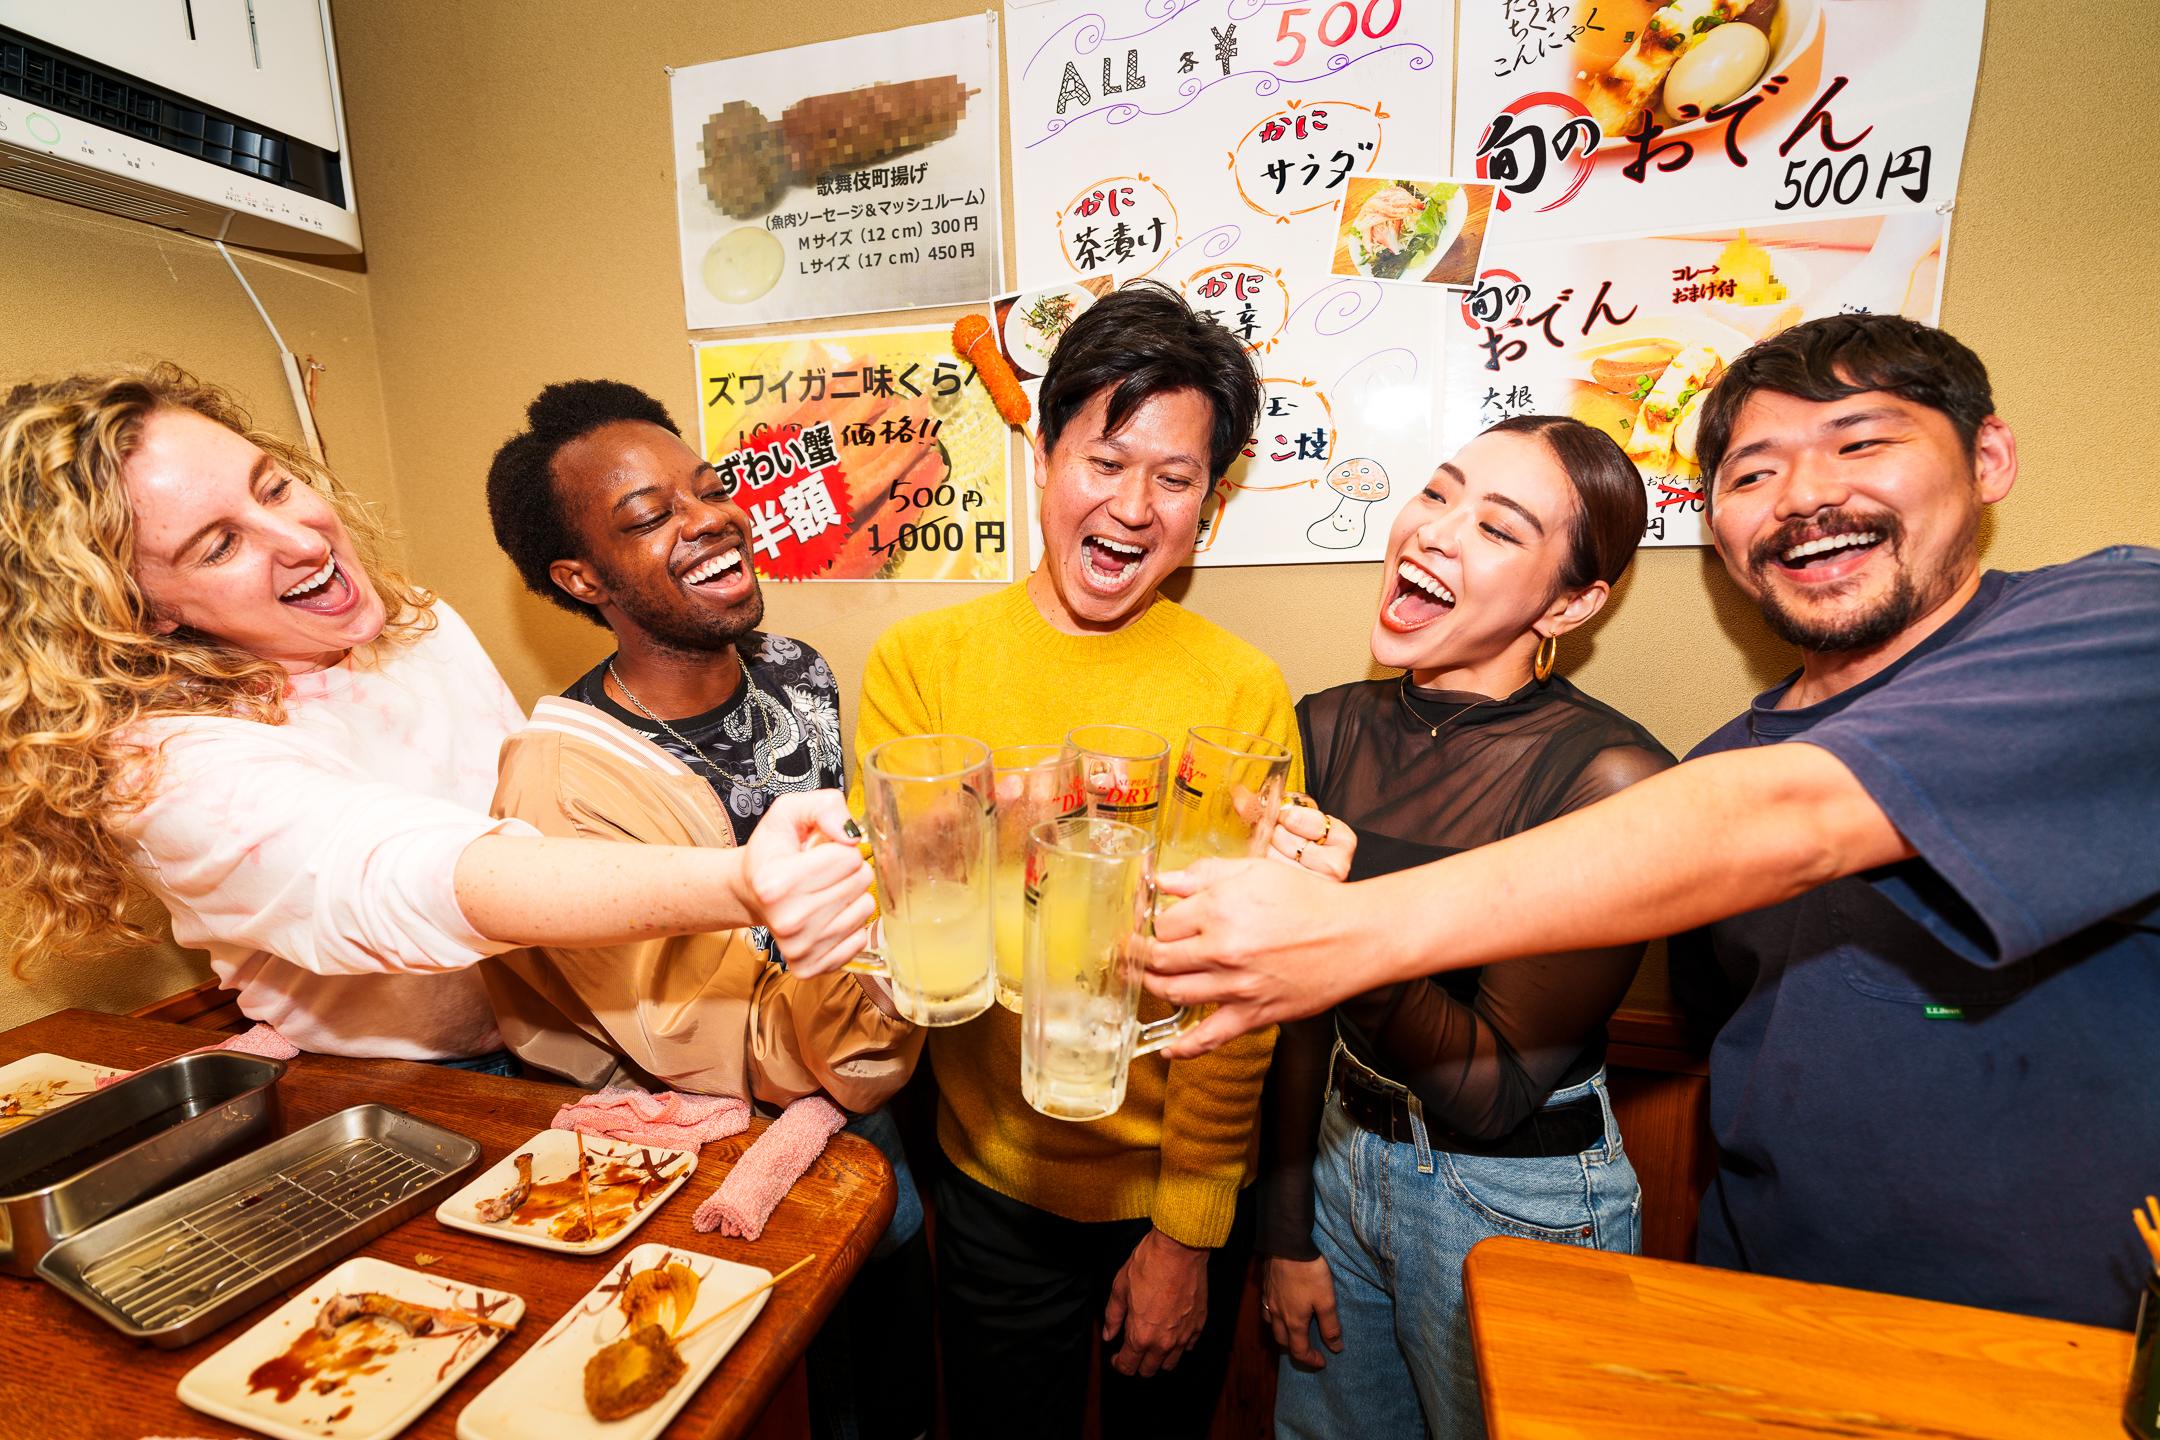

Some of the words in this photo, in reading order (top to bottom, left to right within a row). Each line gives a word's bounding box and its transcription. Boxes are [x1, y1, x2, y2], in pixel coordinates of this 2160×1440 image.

[1056, 49, 1146, 114] ALL
[1260, 110, 1328, 143] かに
[816, 162, 928, 197] 歌舞伎町揚げ
[1260, 142, 1374, 194] サラダ
[1074, 187, 1135, 217] かに
[1073, 217, 1167, 270] 茶漬け
[1198, 271, 1264, 301] かに
[1672, 282, 1738, 304] おまけ付
[708, 362, 978, 408] ズワイガニ味くら
[1480, 385, 1534, 410] 大根
[714, 424, 838, 495] ずわい蟹
[889, 478, 983, 513] 500円
[750, 471, 842, 560] 半額
